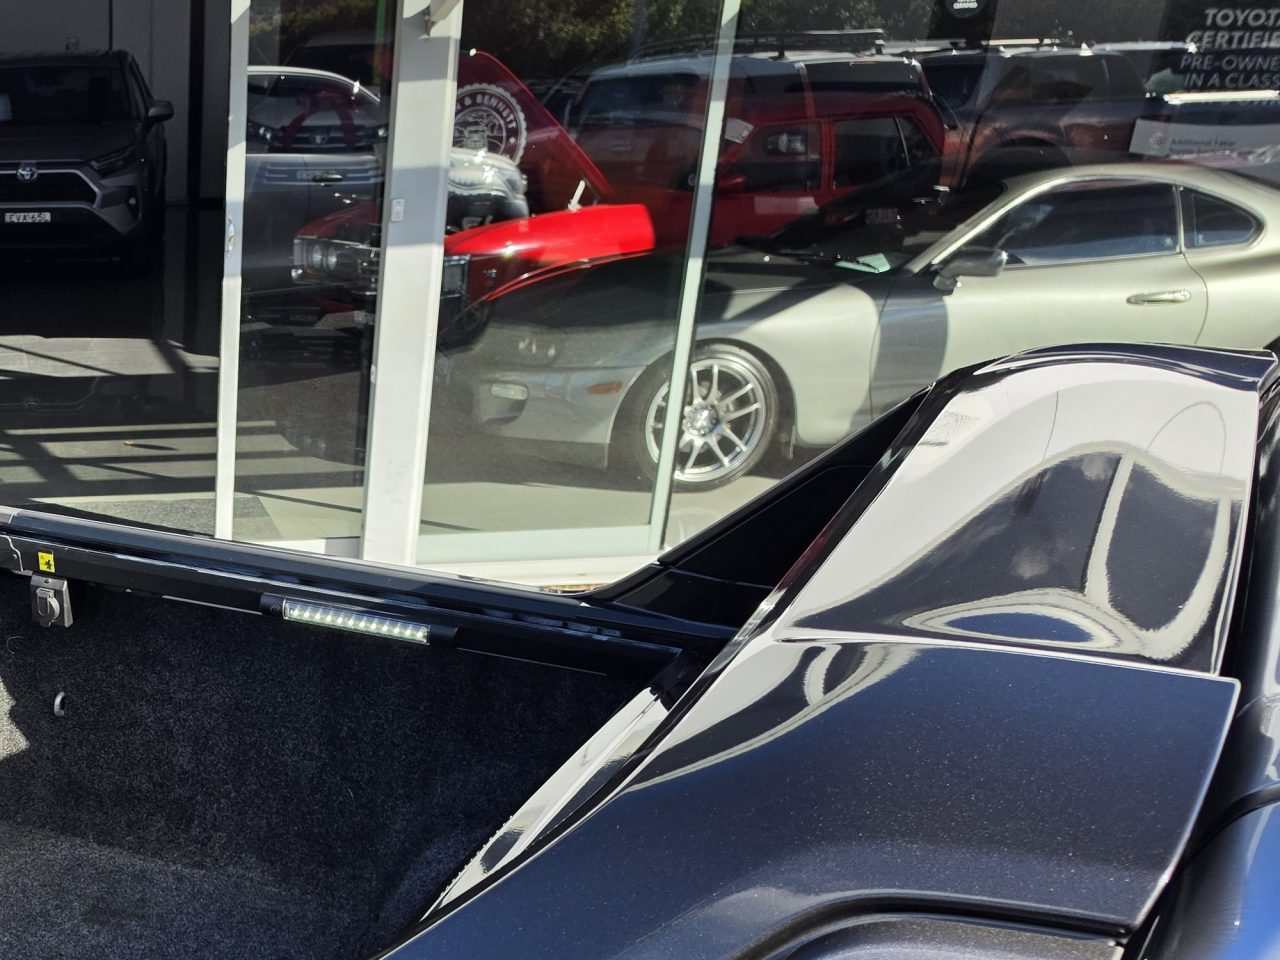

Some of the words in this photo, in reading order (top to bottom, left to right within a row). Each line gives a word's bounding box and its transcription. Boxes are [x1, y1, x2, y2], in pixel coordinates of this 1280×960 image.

[1186, 31, 1280, 50] CERTIFIE
[1180, 54, 1280, 71] PRE-OWNE
[1184, 72, 1204, 88] IN
[1207, 73, 1220, 88] A
